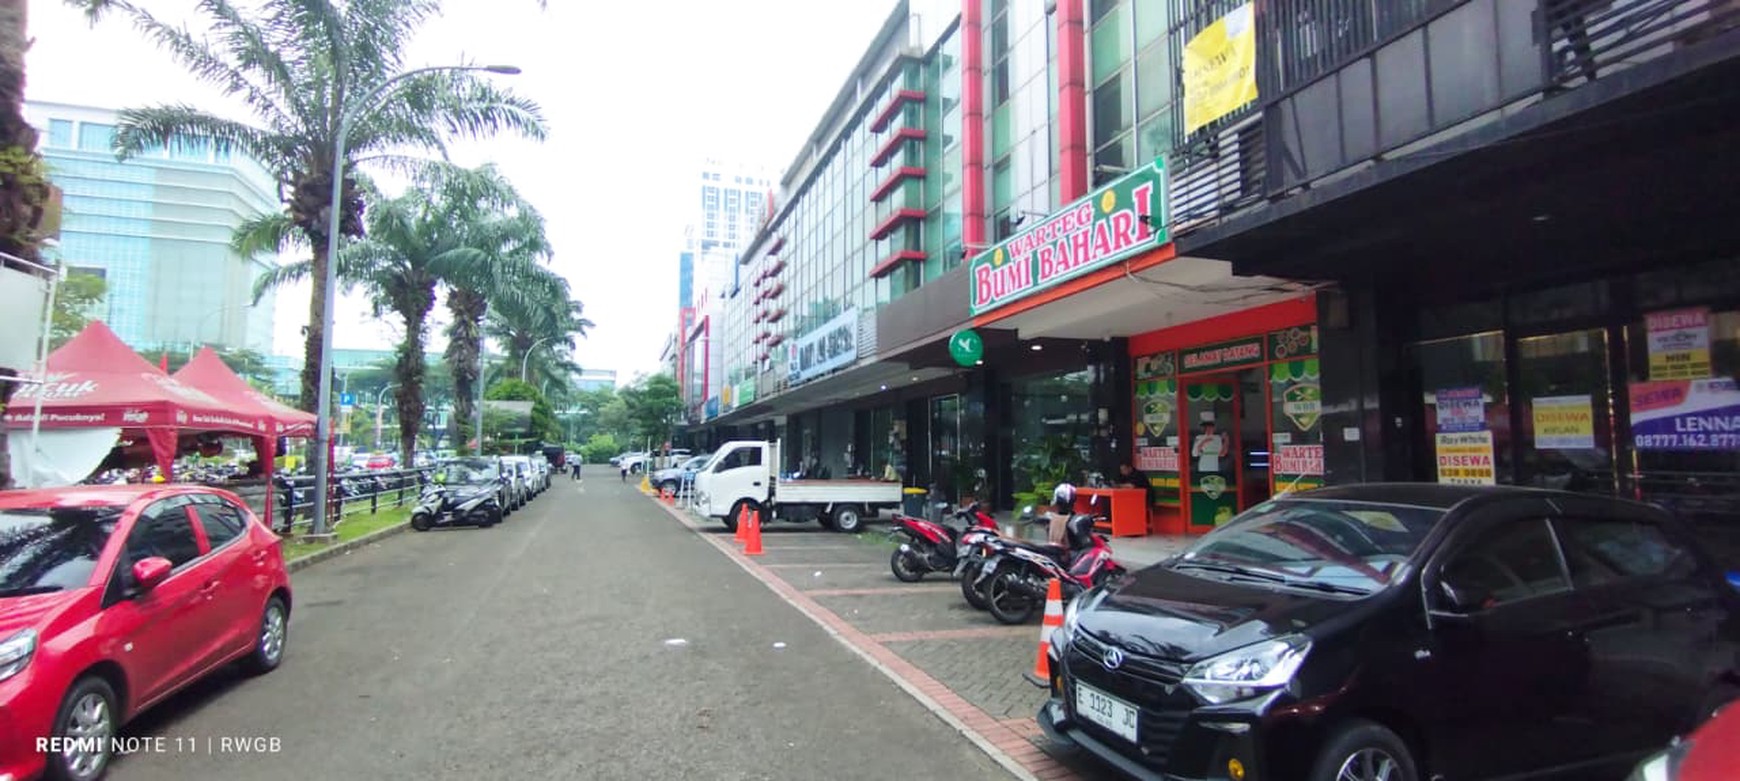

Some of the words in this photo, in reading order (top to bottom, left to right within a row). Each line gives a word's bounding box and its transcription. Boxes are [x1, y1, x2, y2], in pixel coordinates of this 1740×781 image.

[975, 257, 1033, 306] BUMI
[1038, 181, 1154, 282] BAHARI
[1008, 202, 1094, 259] WARTEG
[1635, 434, 1740, 448] 08777.162.877
[1439, 455, 1491, 467] DISEWA
[1078, 686, 1084, 704] E
[1089, 692, 1113, 718] 1123
